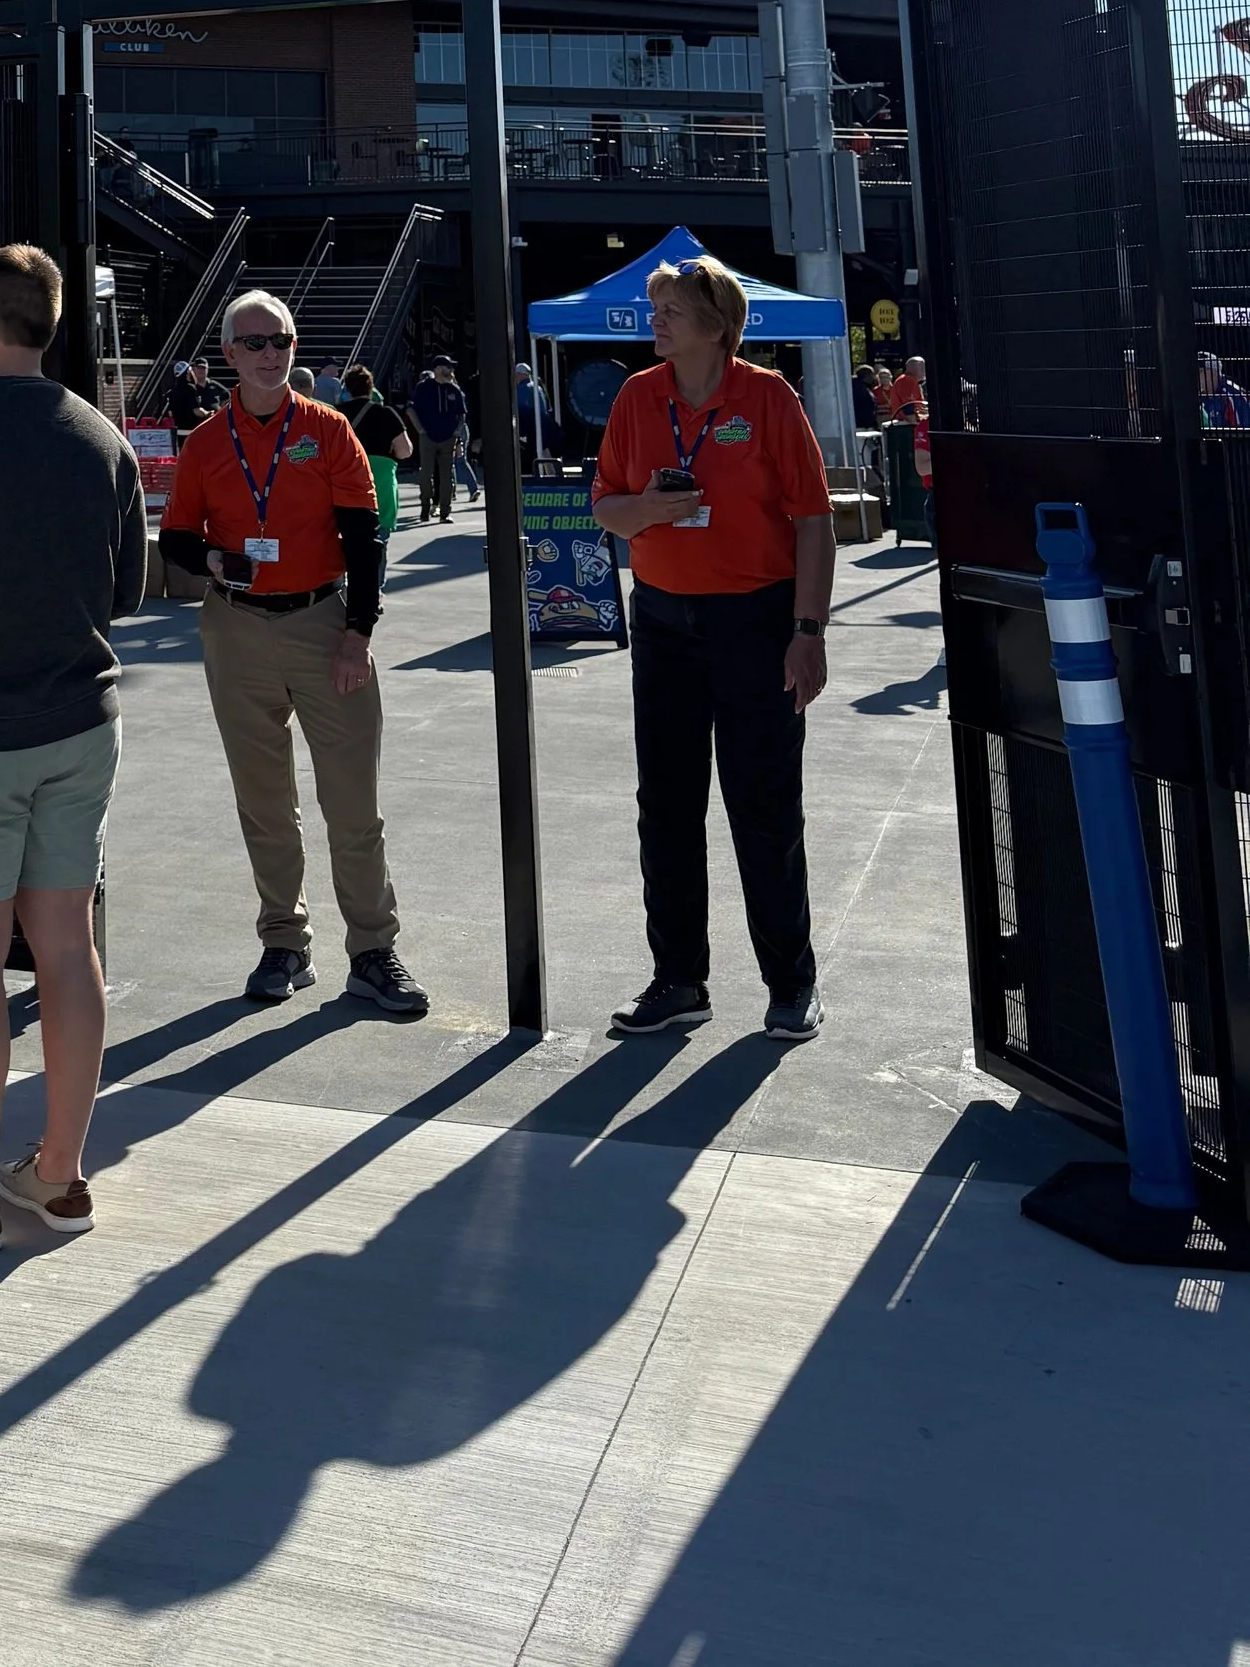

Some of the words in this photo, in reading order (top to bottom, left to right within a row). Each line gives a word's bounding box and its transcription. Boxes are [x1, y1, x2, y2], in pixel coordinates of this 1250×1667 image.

[119, 42, 150, 52] CLUB
[522, 492, 570, 507] EWARE
[572, 492, 589, 507] OF
